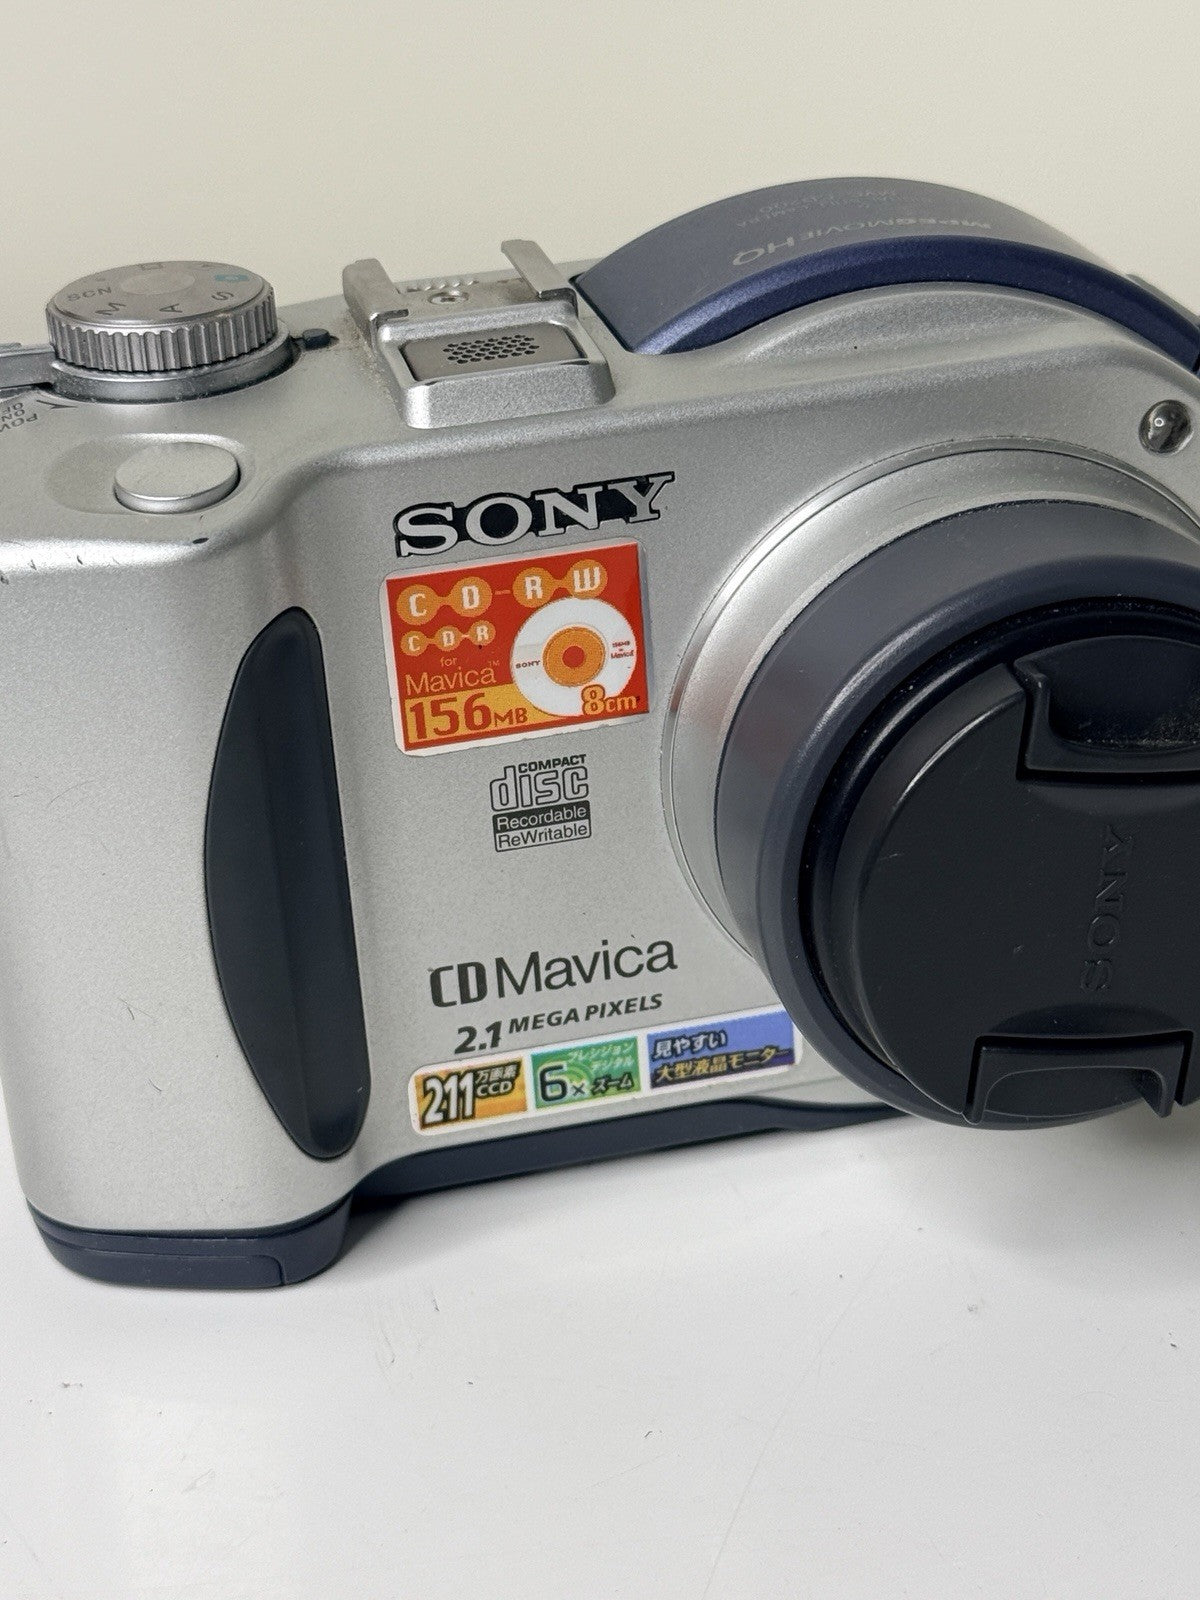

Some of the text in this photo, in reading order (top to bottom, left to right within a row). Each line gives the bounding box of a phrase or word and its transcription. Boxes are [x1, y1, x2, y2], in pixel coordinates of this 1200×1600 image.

[94, 301, 126, 317] M
[159, 303, 183, 314] A
[394, 471, 675, 557] SONY
[408, 566, 601, 617] CD-RW
[408, 624, 489, 652] CD-R
[440, 656, 457, 668] for
[515, 660, 541, 669] SONY
[581, 684, 637, 716] 8cm
[409, 692, 528, 739] 156MB
[518, 754, 586, 773] COMPACT
[490, 765, 589, 812] disc
[496, 805, 587, 831] Recordable
[498, 823, 588, 849] ReWritable
[1080, 824, 1136, 992] SONY
[429, 939, 678, 1008] CD Mavica
[454, 993, 663, 1054] 2.1 MEGA PIXELS
[654, 1030, 728, 1059] 見やすい
[656, 1046, 790, 1083] 大型液晶モニター
[422, 1071, 475, 1125] 211
[476, 1080, 514, 1097] CCD
[591, 1072, 636, 1096] ズーム
